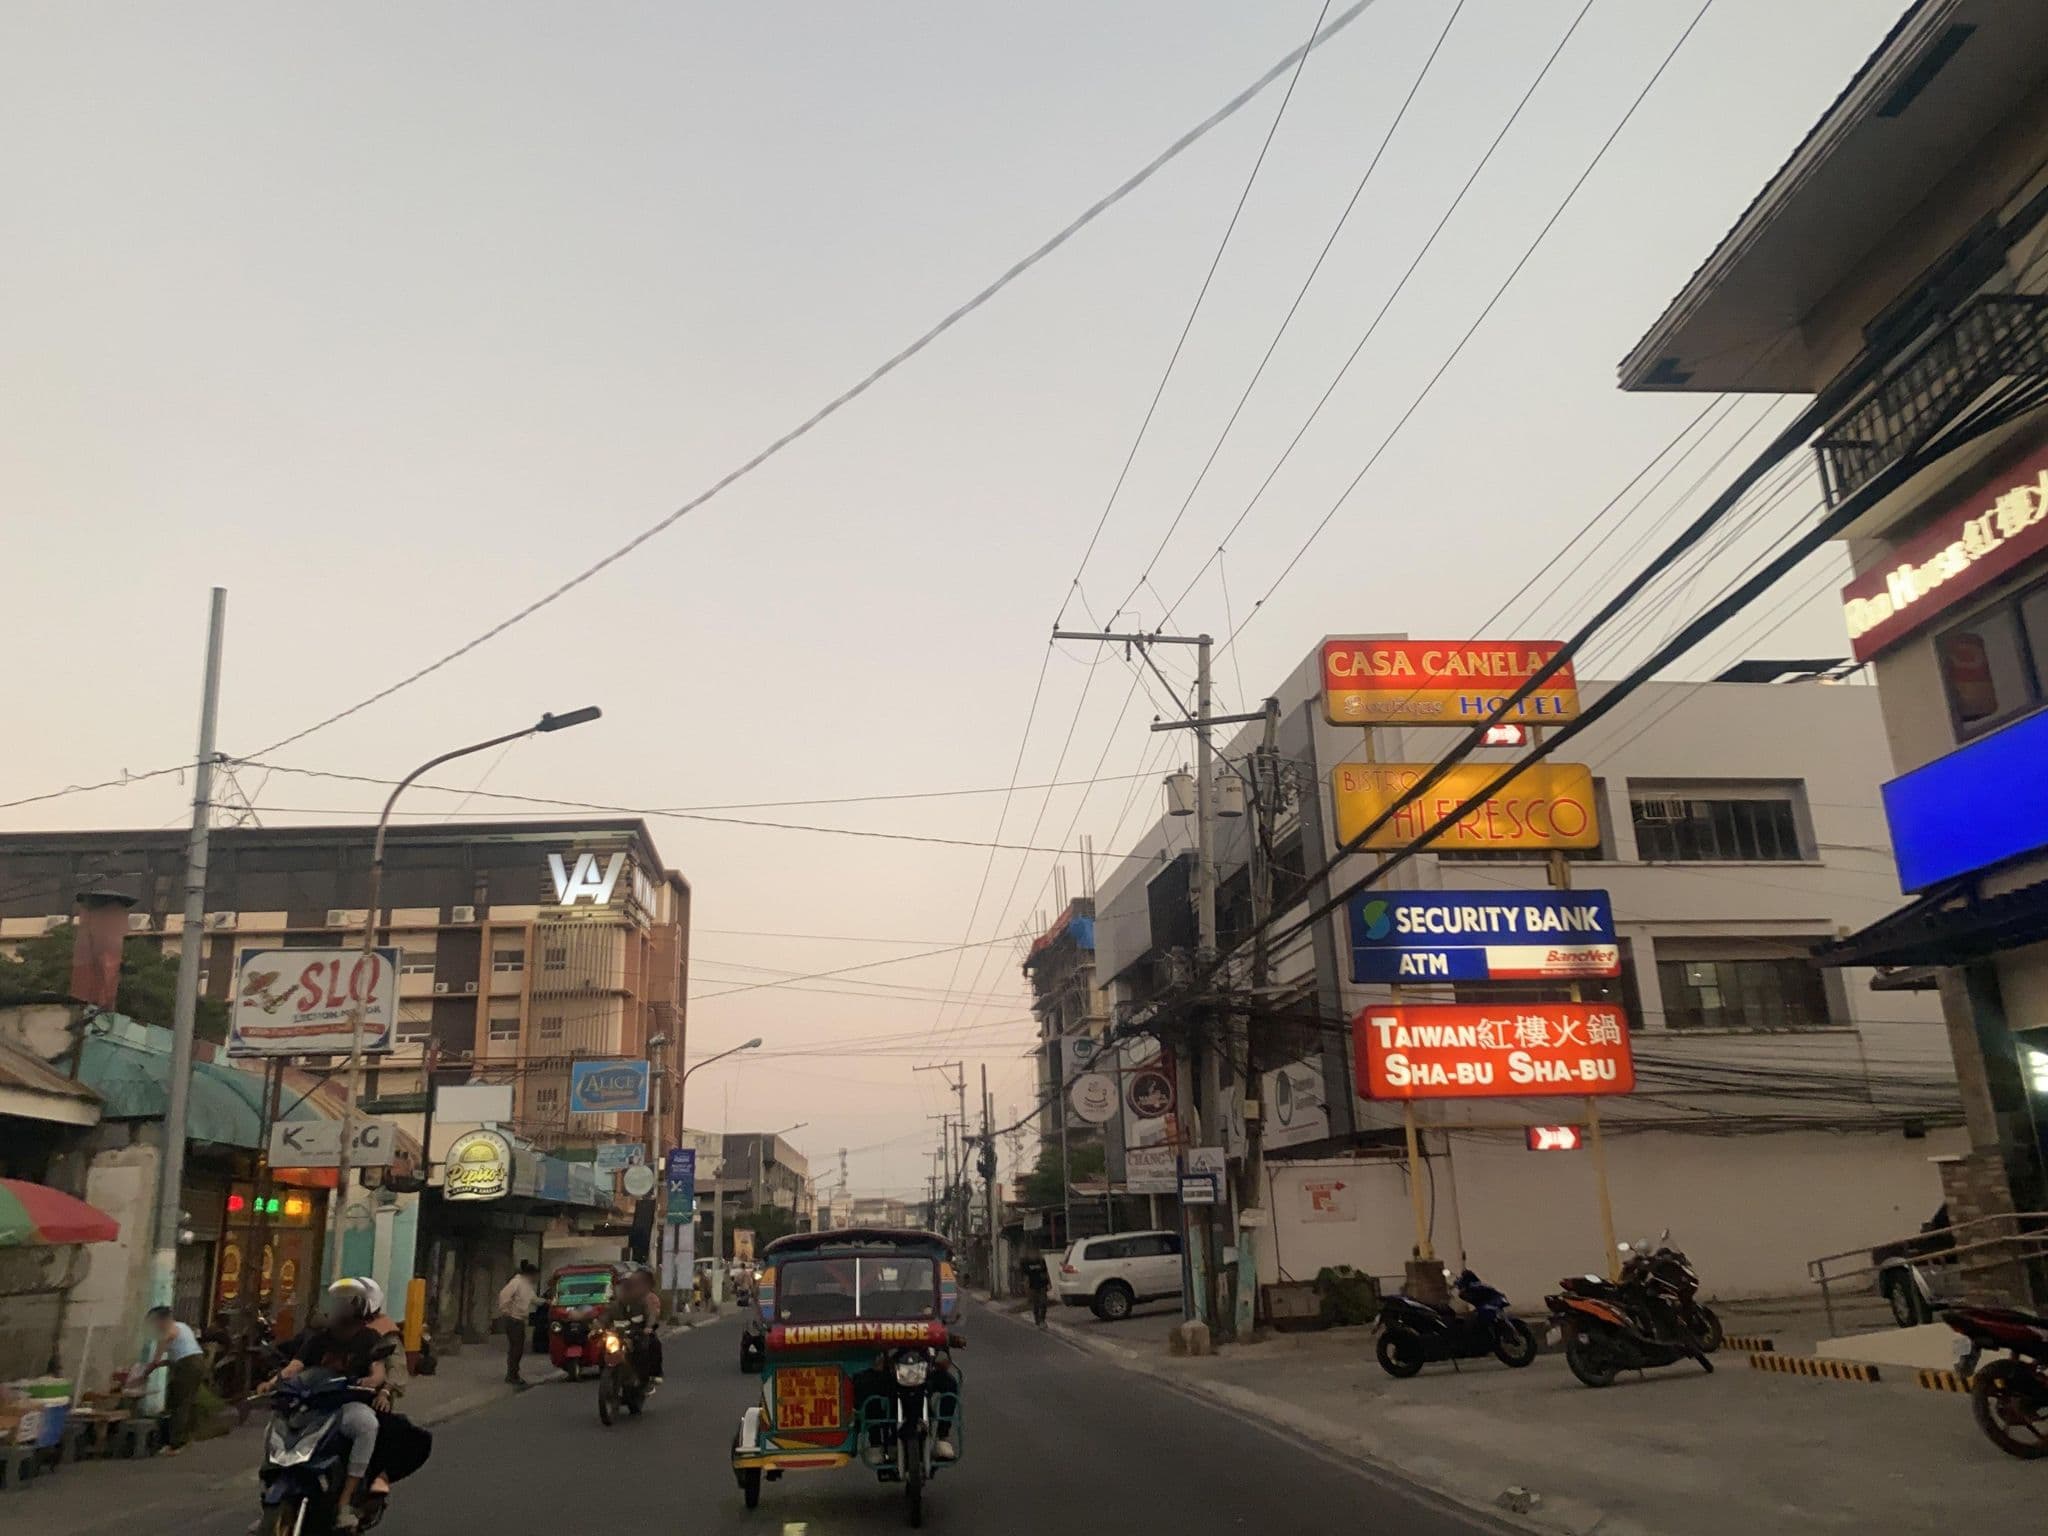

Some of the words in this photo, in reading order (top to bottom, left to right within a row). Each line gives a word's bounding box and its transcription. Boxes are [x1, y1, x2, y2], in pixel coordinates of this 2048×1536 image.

[1328, 651, 1416, 676] CASA
[1459, 696, 1569, 715] HOTEL
[1343, 770, 1420, 792] BISTRO
[1395, 906, 1520, 934] SECURITY
[1525, 905, 1603, 932] BANK
[1399, 953, 1449, 975] ATM
[1547, 950, 1615, 962] BancNet
[784, 1322, 878, 1345] KIMBERLY
[881, 1321, 929, 1341] ROSE
